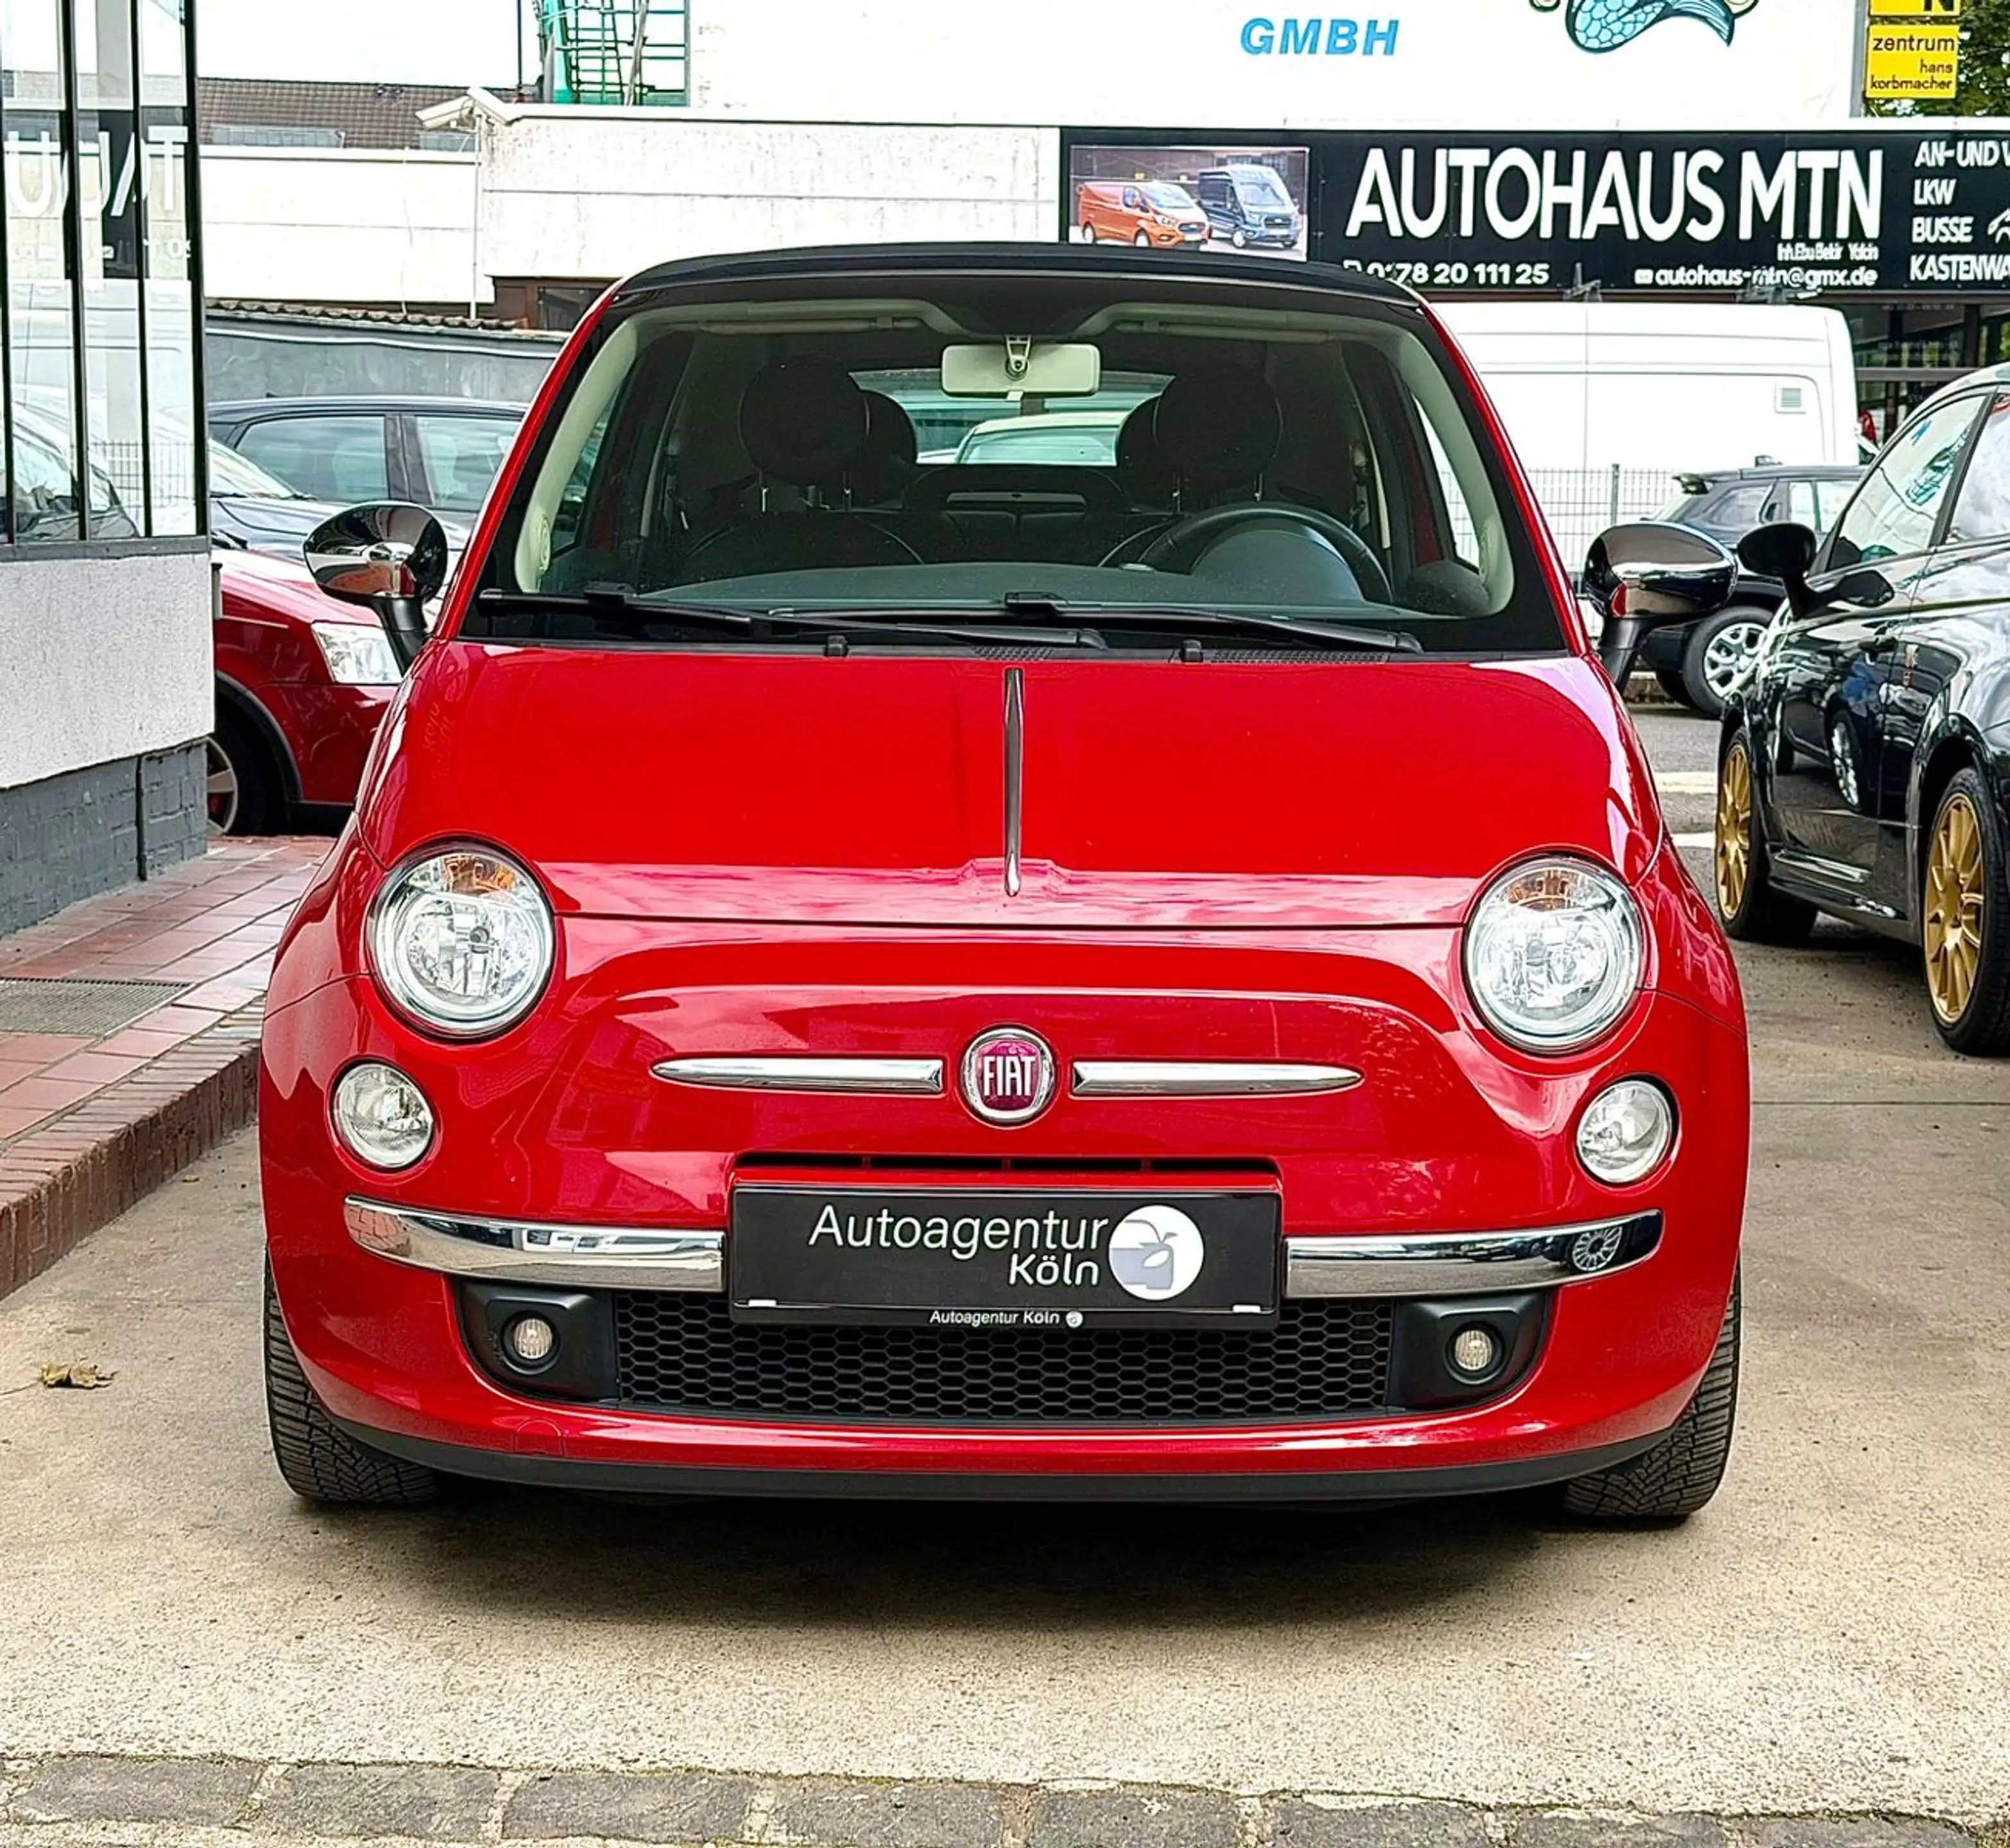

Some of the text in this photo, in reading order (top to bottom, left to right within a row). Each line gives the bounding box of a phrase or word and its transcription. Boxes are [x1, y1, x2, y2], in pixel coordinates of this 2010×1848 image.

[1241, 18, 1399, 55] GMBH
[1873, 35, 1954, 51] zentrum
[1920, 58, 1953, 73] hans
[1870, 74, 1952, 89] korbmacher
[1346, 148, 1883, 241] AUTOHAUS MTN
[1914, 178, 1957, 205] LKW
[1912, 216, 1974, 243] BUSSE
[1433, 262, 1468, 284] 20
[1473, 263, 1511, 284] 111
[1515, 263, 1550, 284] 25
[983, 1056, 1036, 1096] FIAT
[809, 1205, 1108, 1260] Autoagentur
[1009, 1253, 1099, 1285] Köln
[930, 1311, 1060, 1327] Autoagentur Köln
